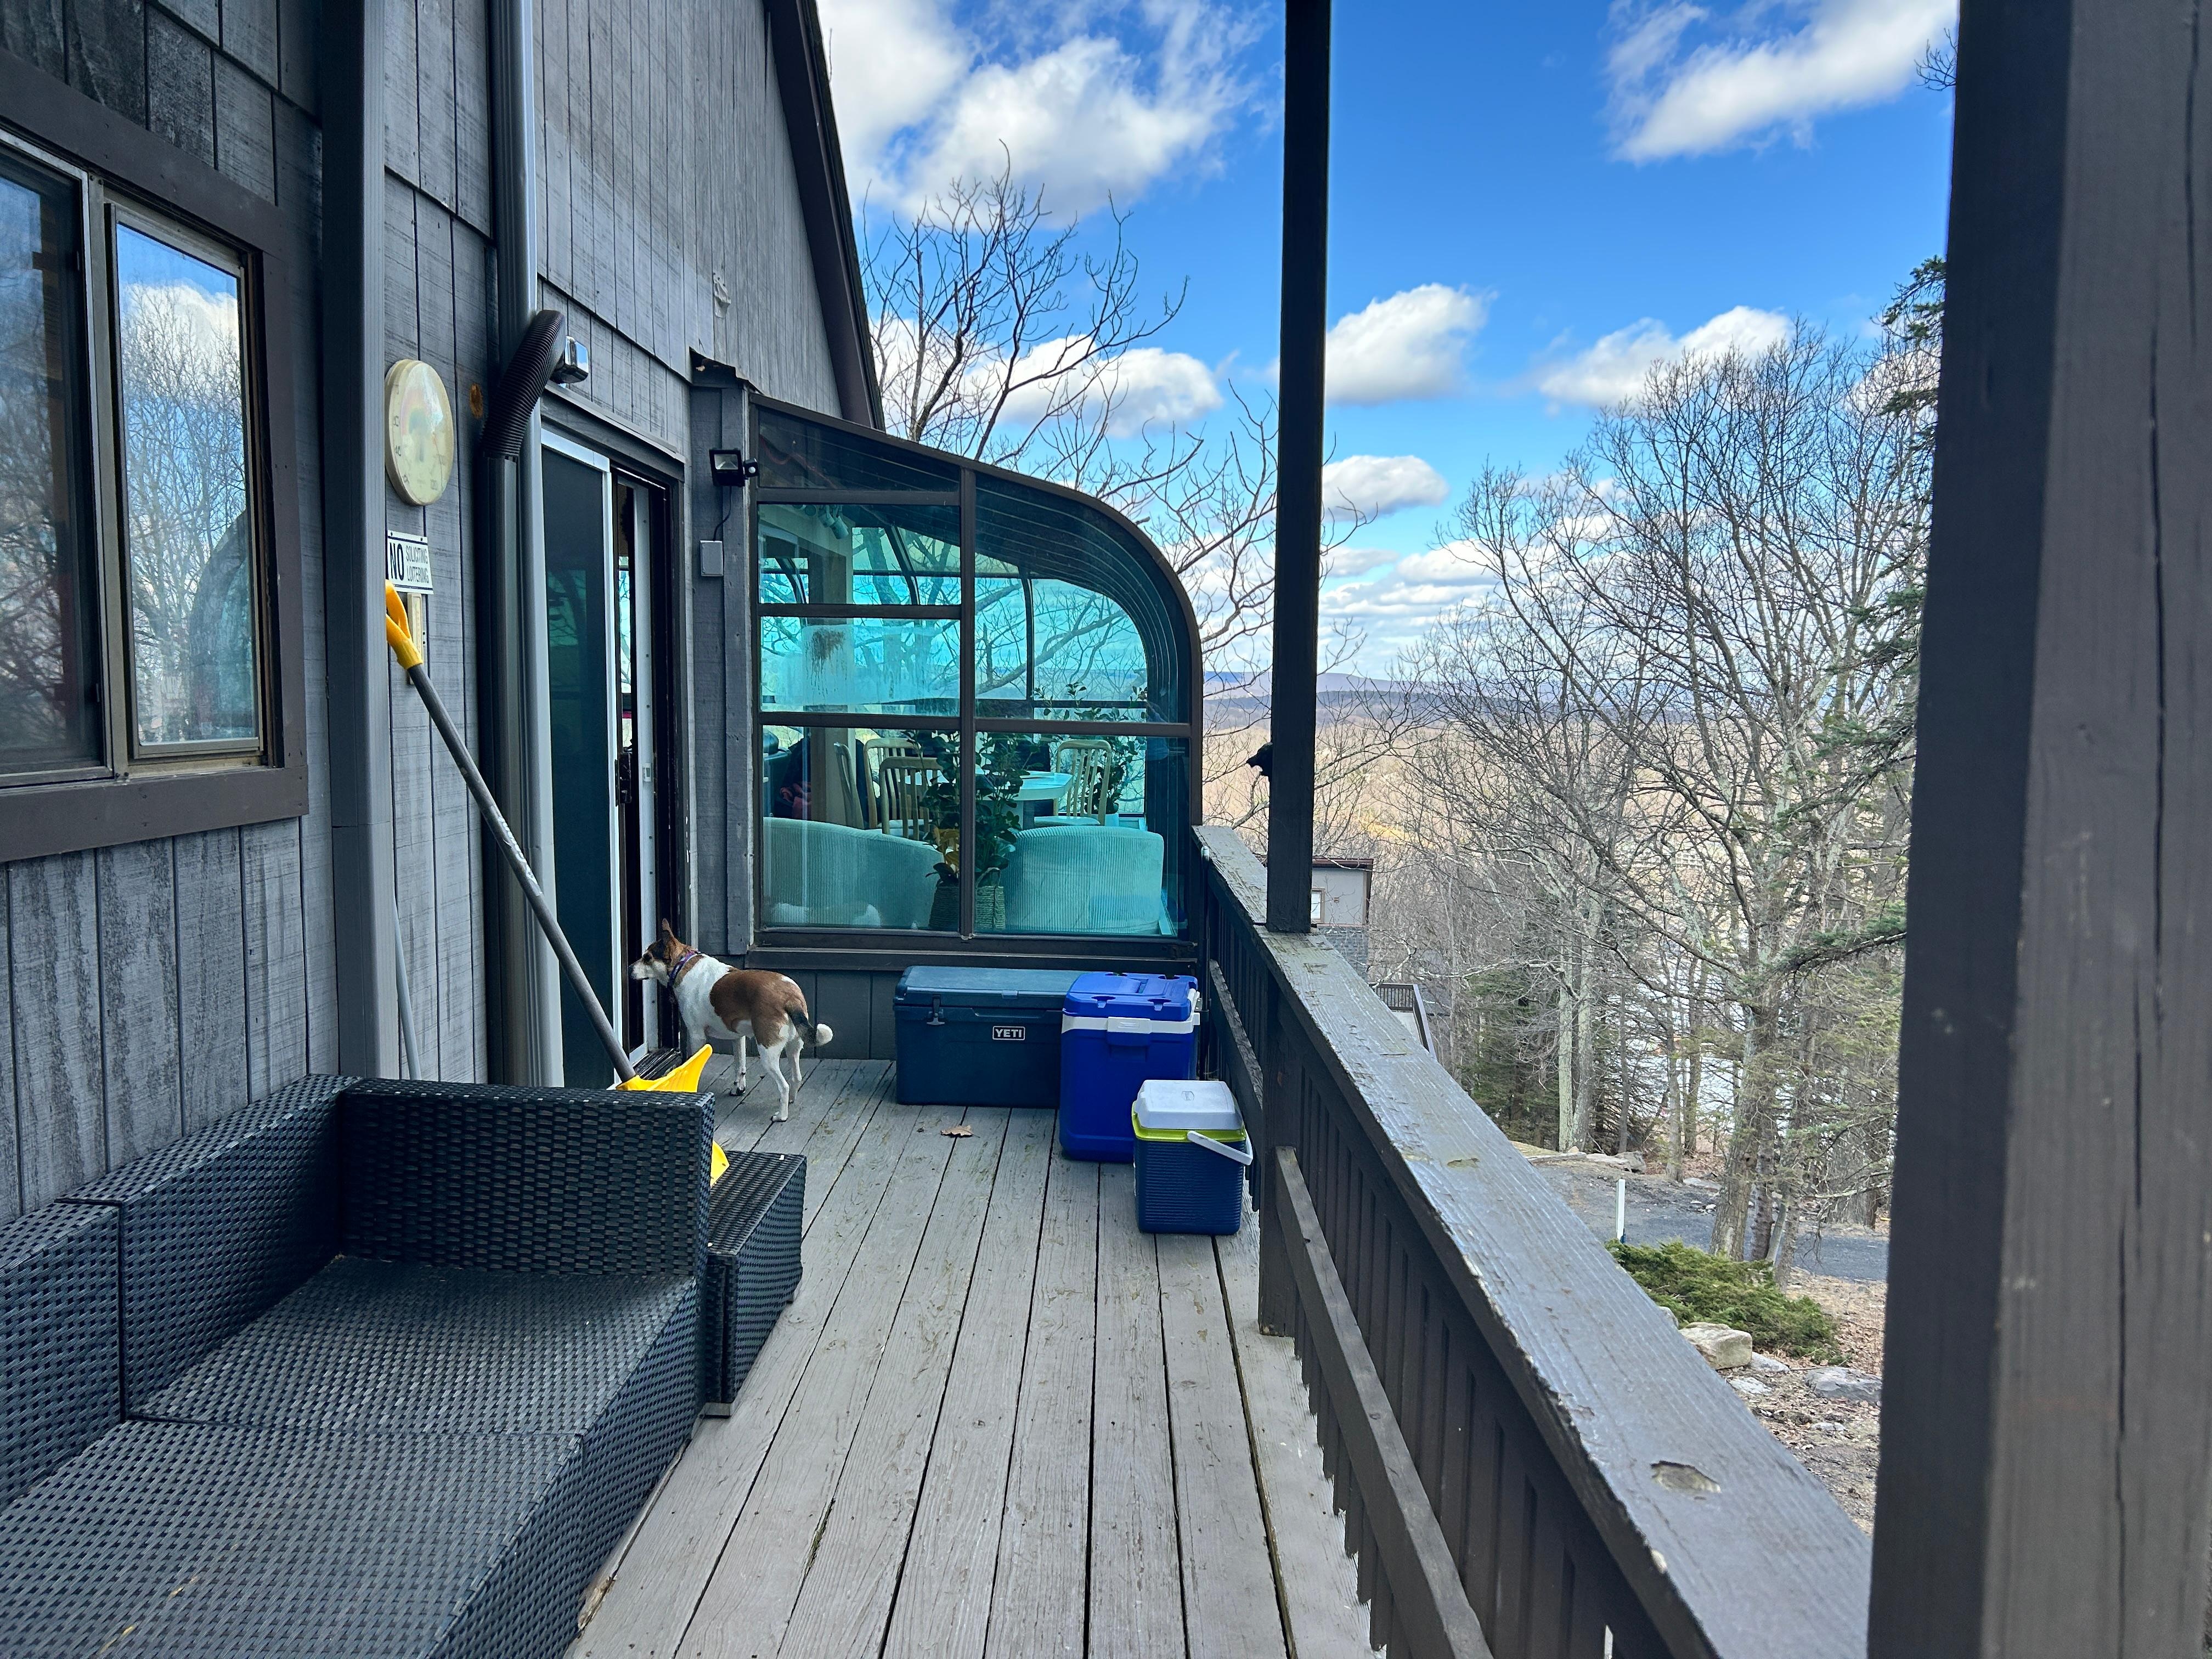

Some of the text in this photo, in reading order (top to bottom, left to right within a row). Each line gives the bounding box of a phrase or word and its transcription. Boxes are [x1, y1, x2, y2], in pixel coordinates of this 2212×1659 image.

[390, 542, 404, 581] NO
[405, 545, 428, 564] SOLICITING
[407, 566, 430, 584] LOITERING
[995, 1029, 1022, 1037] YETI
